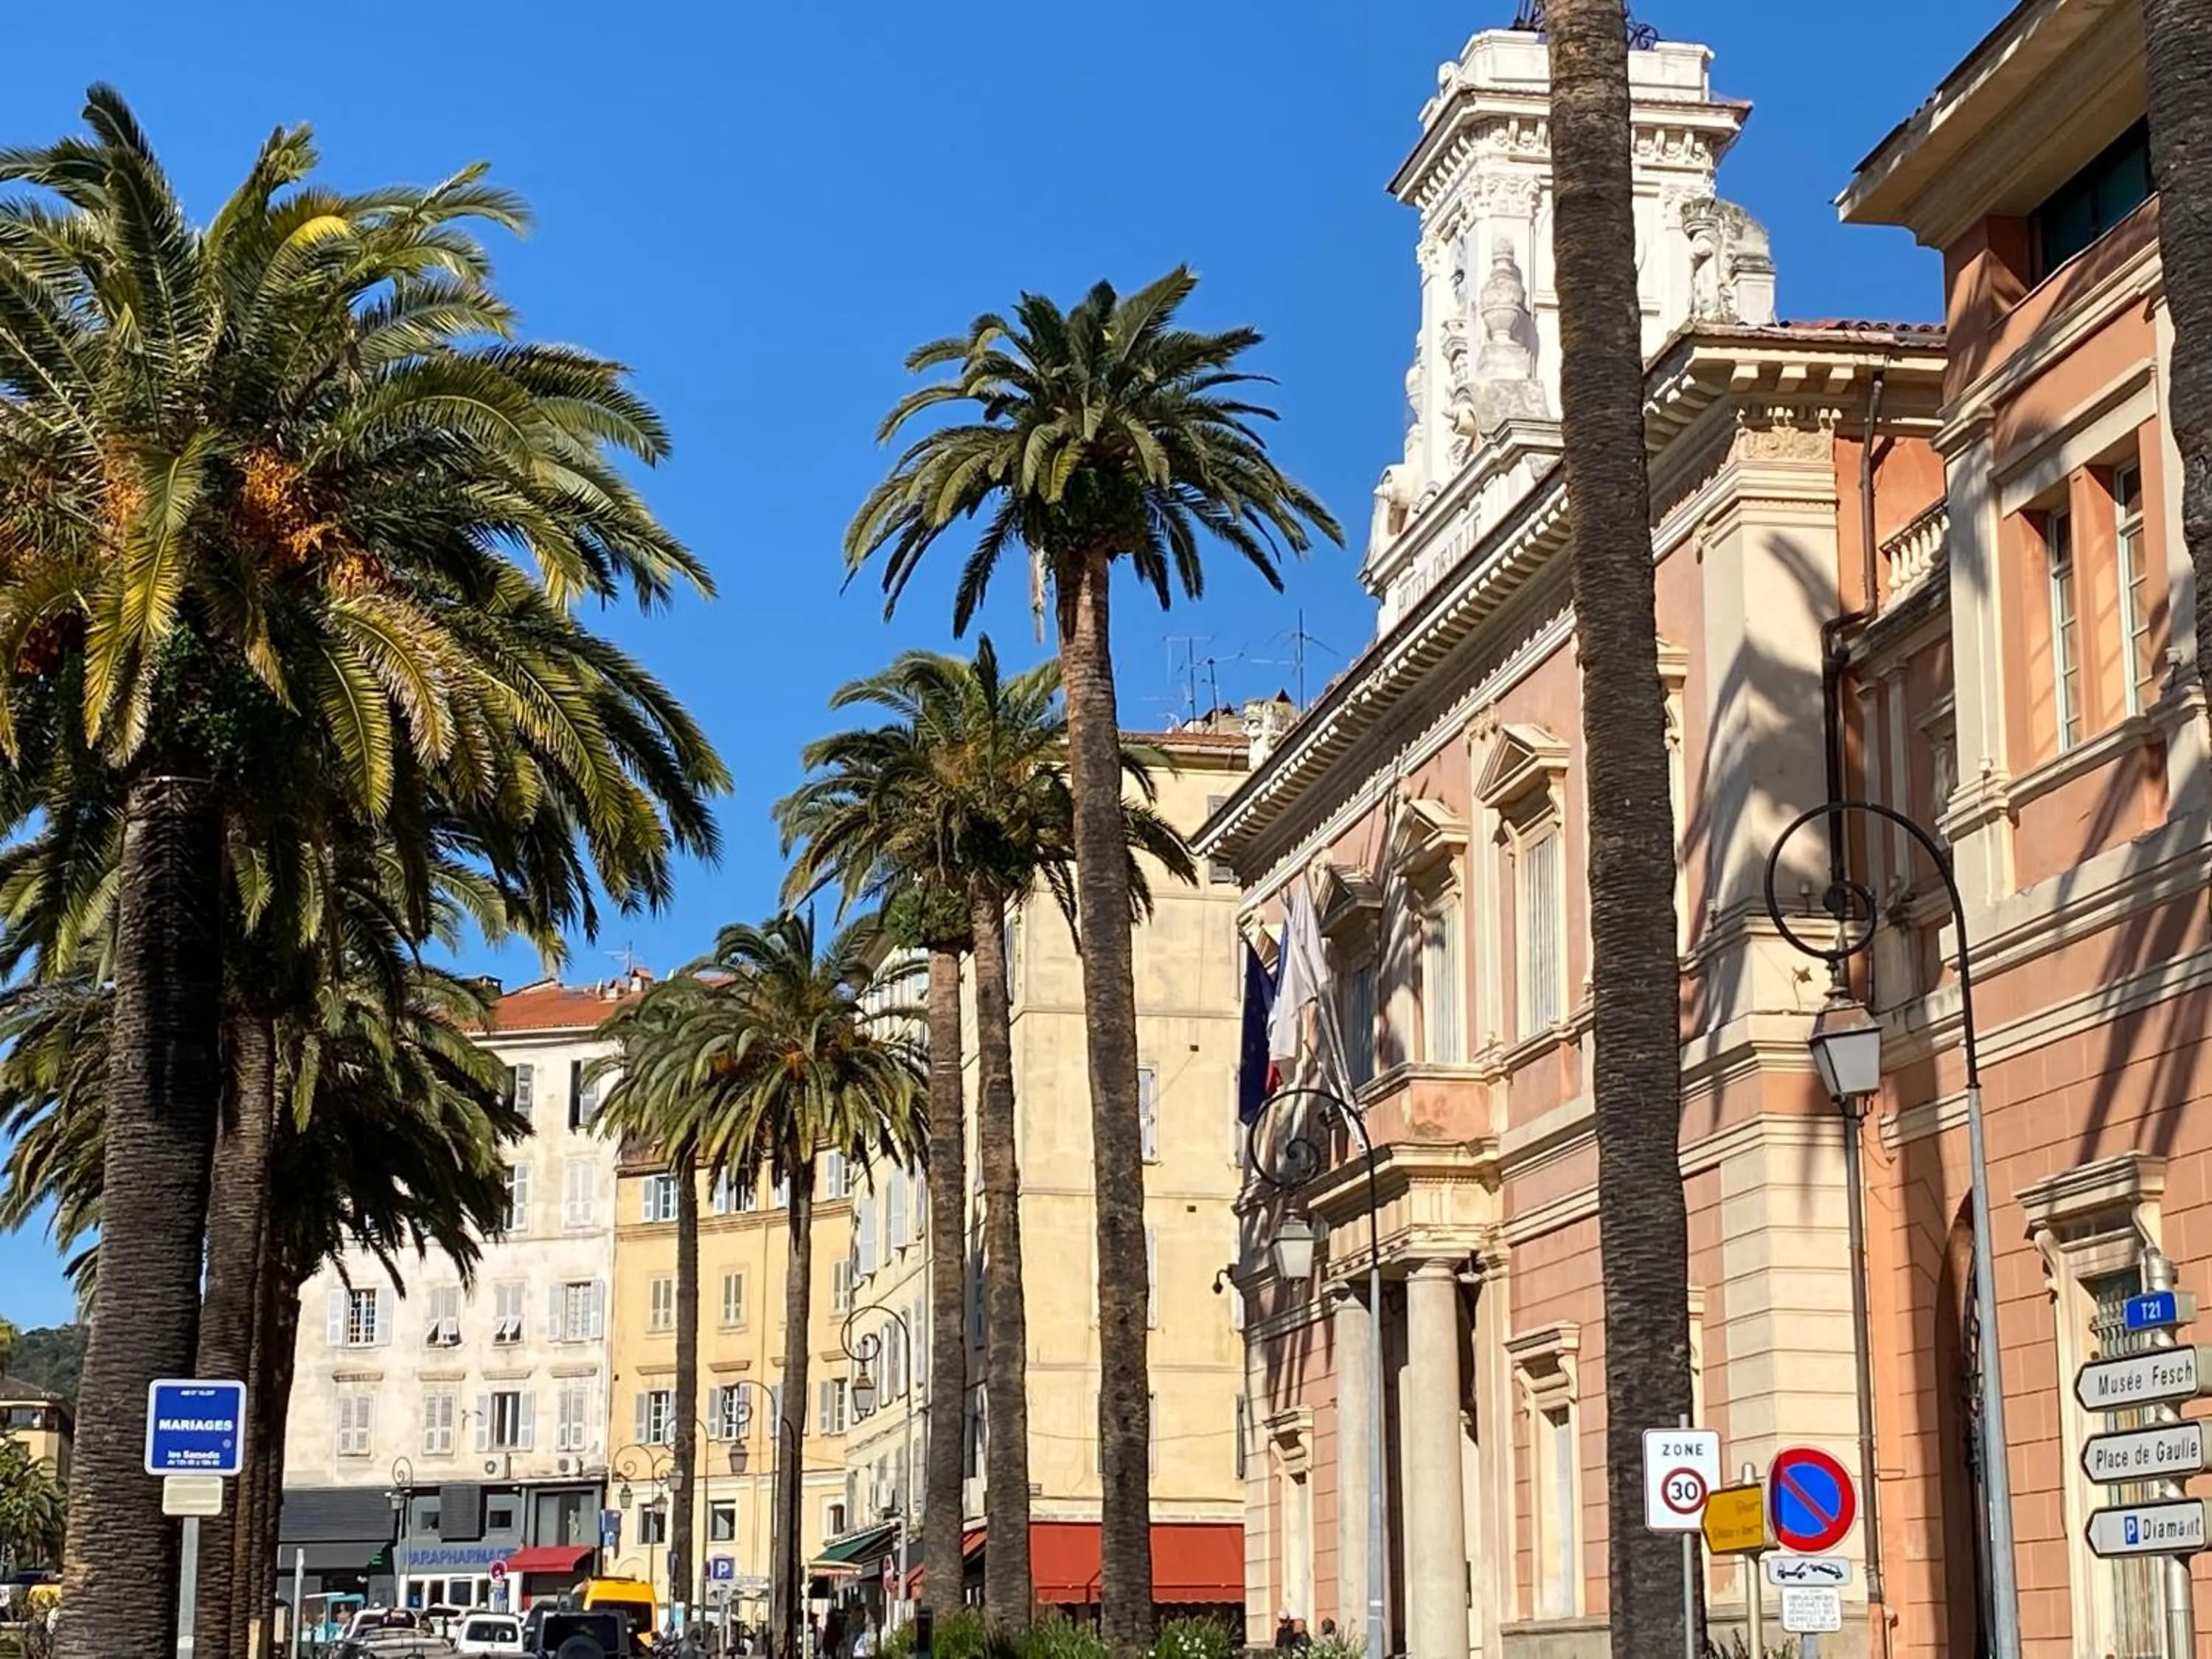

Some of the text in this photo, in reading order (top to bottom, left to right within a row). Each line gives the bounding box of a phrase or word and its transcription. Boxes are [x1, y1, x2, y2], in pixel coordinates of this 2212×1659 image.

[2141, 1300, 2161, 1320] T21
[2098, 1360, 2192, 1396] Musée Fesch
[159, 1419, 234, 1431] MARIAGES
[1663, 1443, 1704, 1456] ZONE
[2096, 1438, 2198, 1470] Place de Gaulle
[1671, 1481, 1699, 1501] 30
[2126, 1516, 2201, 1544] P Diamant
[717, 1560, 730, 1577] P
